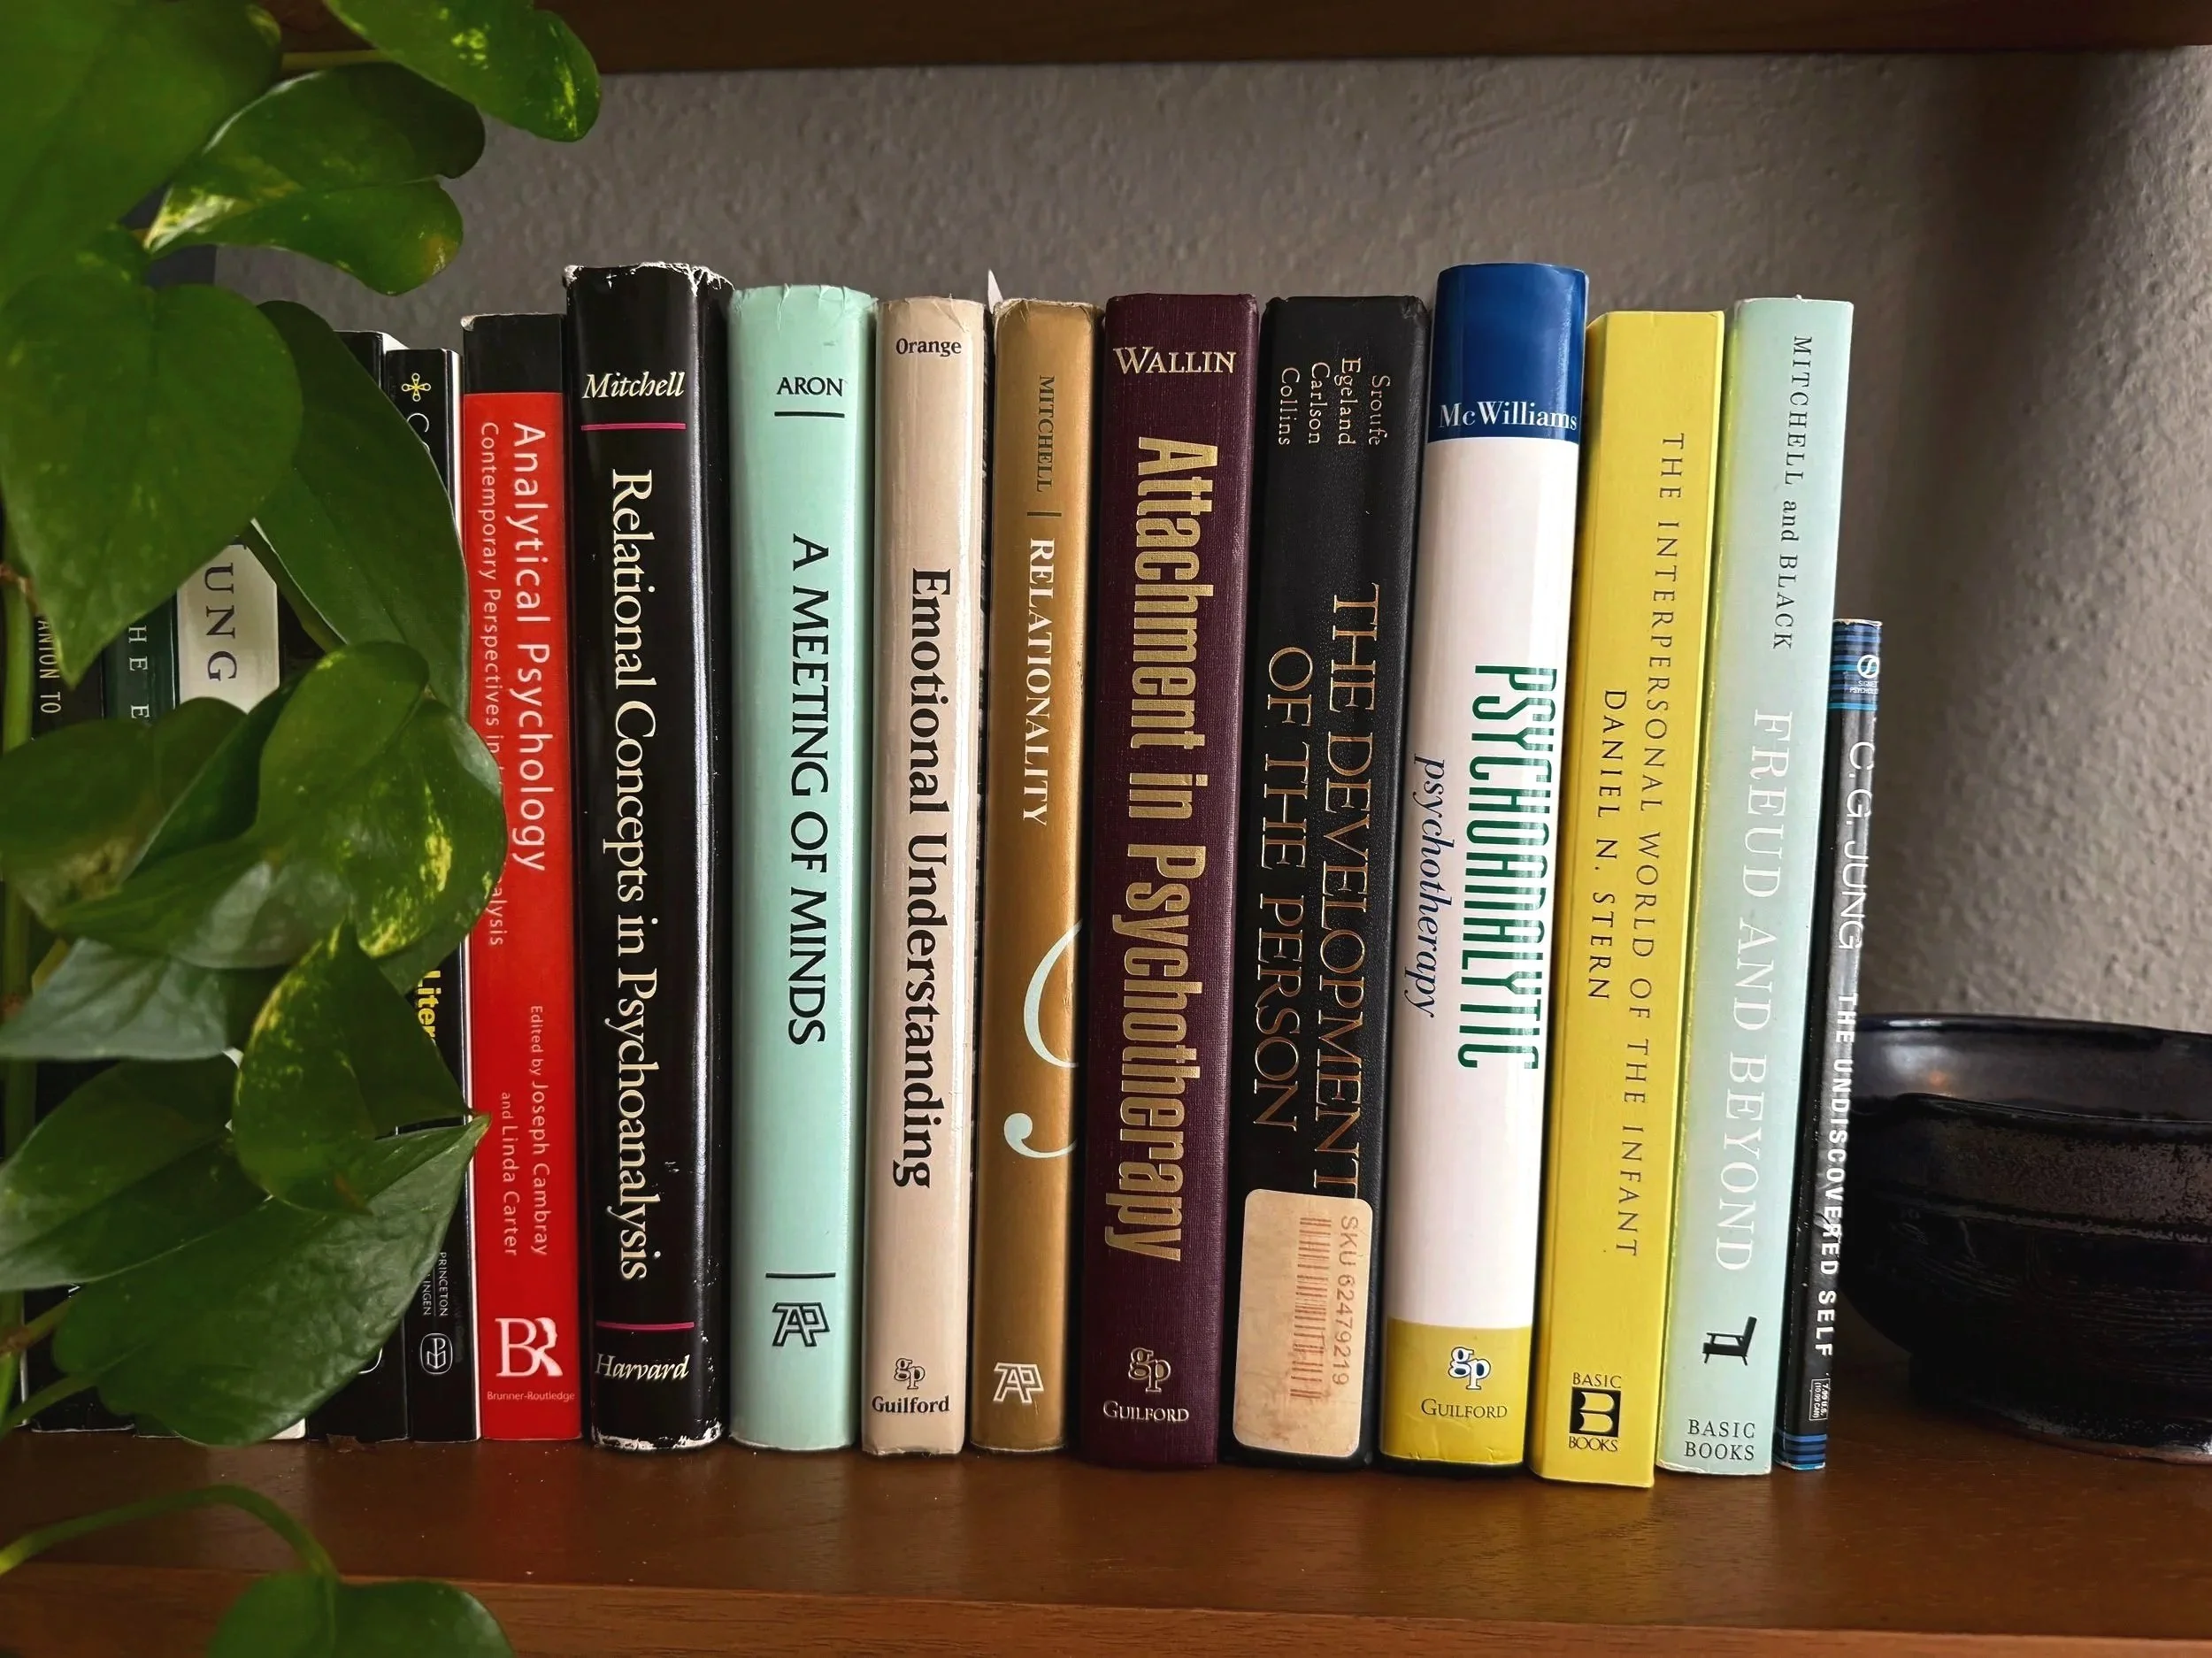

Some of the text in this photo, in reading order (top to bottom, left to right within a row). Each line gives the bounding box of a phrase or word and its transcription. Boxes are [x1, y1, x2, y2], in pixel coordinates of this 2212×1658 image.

[581, 372, 687, 399] Mitchell
[776, 377, 844, 397] ARON
[895, 338, 962, 357] Orange
[1112, 346, 1236, 375] WALLIN
[1279, 367, 1300, 445] Collins
[1309, 362, 1331, 444] Carlson
[1333, 357, 1361, 445] Egeland
[1036, 374, 1056, 493] MITCHELL
[1368, 375, 1391, 445] Sroufe
[1439, 400, 1577, 431] McWilliams
[478, 422, 499, 580] Contemporary
[1773, 335, 1812, 649] MITCHELL and BLACK
[204, 562, 237, 681] UNG
[480, 589, 502, 726] Perspectives
[505, 422, 555, 871] Analytical Psychology
[40, 691, 61, 713] TO
[1023, 538, 1056, 826] RELATIONALITY
[787, 533, 830, 1047] A MEETING OF MINDS
[1104, 436, 1218, 1262] Attachment in Psychotherapy
[1587, 690, 1627, 1000] DANIEL N. STERN
[1616, 433, 1685, 1256] THE INTERPERSONAL WORLD OF THE INFANT
[1838, 741, 1876, 949] C. G. JUNG
[486, 887, 507, 946] alysis
[603, 469, 660, 1281] Relational Concepts in Psychoanalysis
[892, 567, 951, 1189] Emotional Understanding
[1253, 647, 1313, 1132] OF THE PERSON
[1313, 582, 1379, 1197] THE DEVELOPMENT
[1403, 752, 1455, 1019] psychotherapy
[1457, 664, 1558, 1070] PSYCHOANALYTIC
[1715, 709, 1793, 1271] FREUD AND BEYOND
[501, 1092, 520, 1256] and Linda Carter
[529, 1005, 551, 1255] Edited by Joseph Cambray
[1815, 993, 1859, 1357] THE UNDISCOVERED SELF
[438, 1252, 449, 1316] PRINCETON
[1338, 1216, 1358, 1267] SKU
[487, 1391, 575, 1402] Brunner-Routledge
[594, 1353, 690, 1382] Harvard
[872, 1395, 949, 1414] Guilford
[1572, 1372, 1622, 1389] BASIC
[1568, 1436, 1618, 1453] BOOKS
[1684, 1441, 1755, 1460] BOOKS
[1687, 1418, 1756, 1439] BASIC
